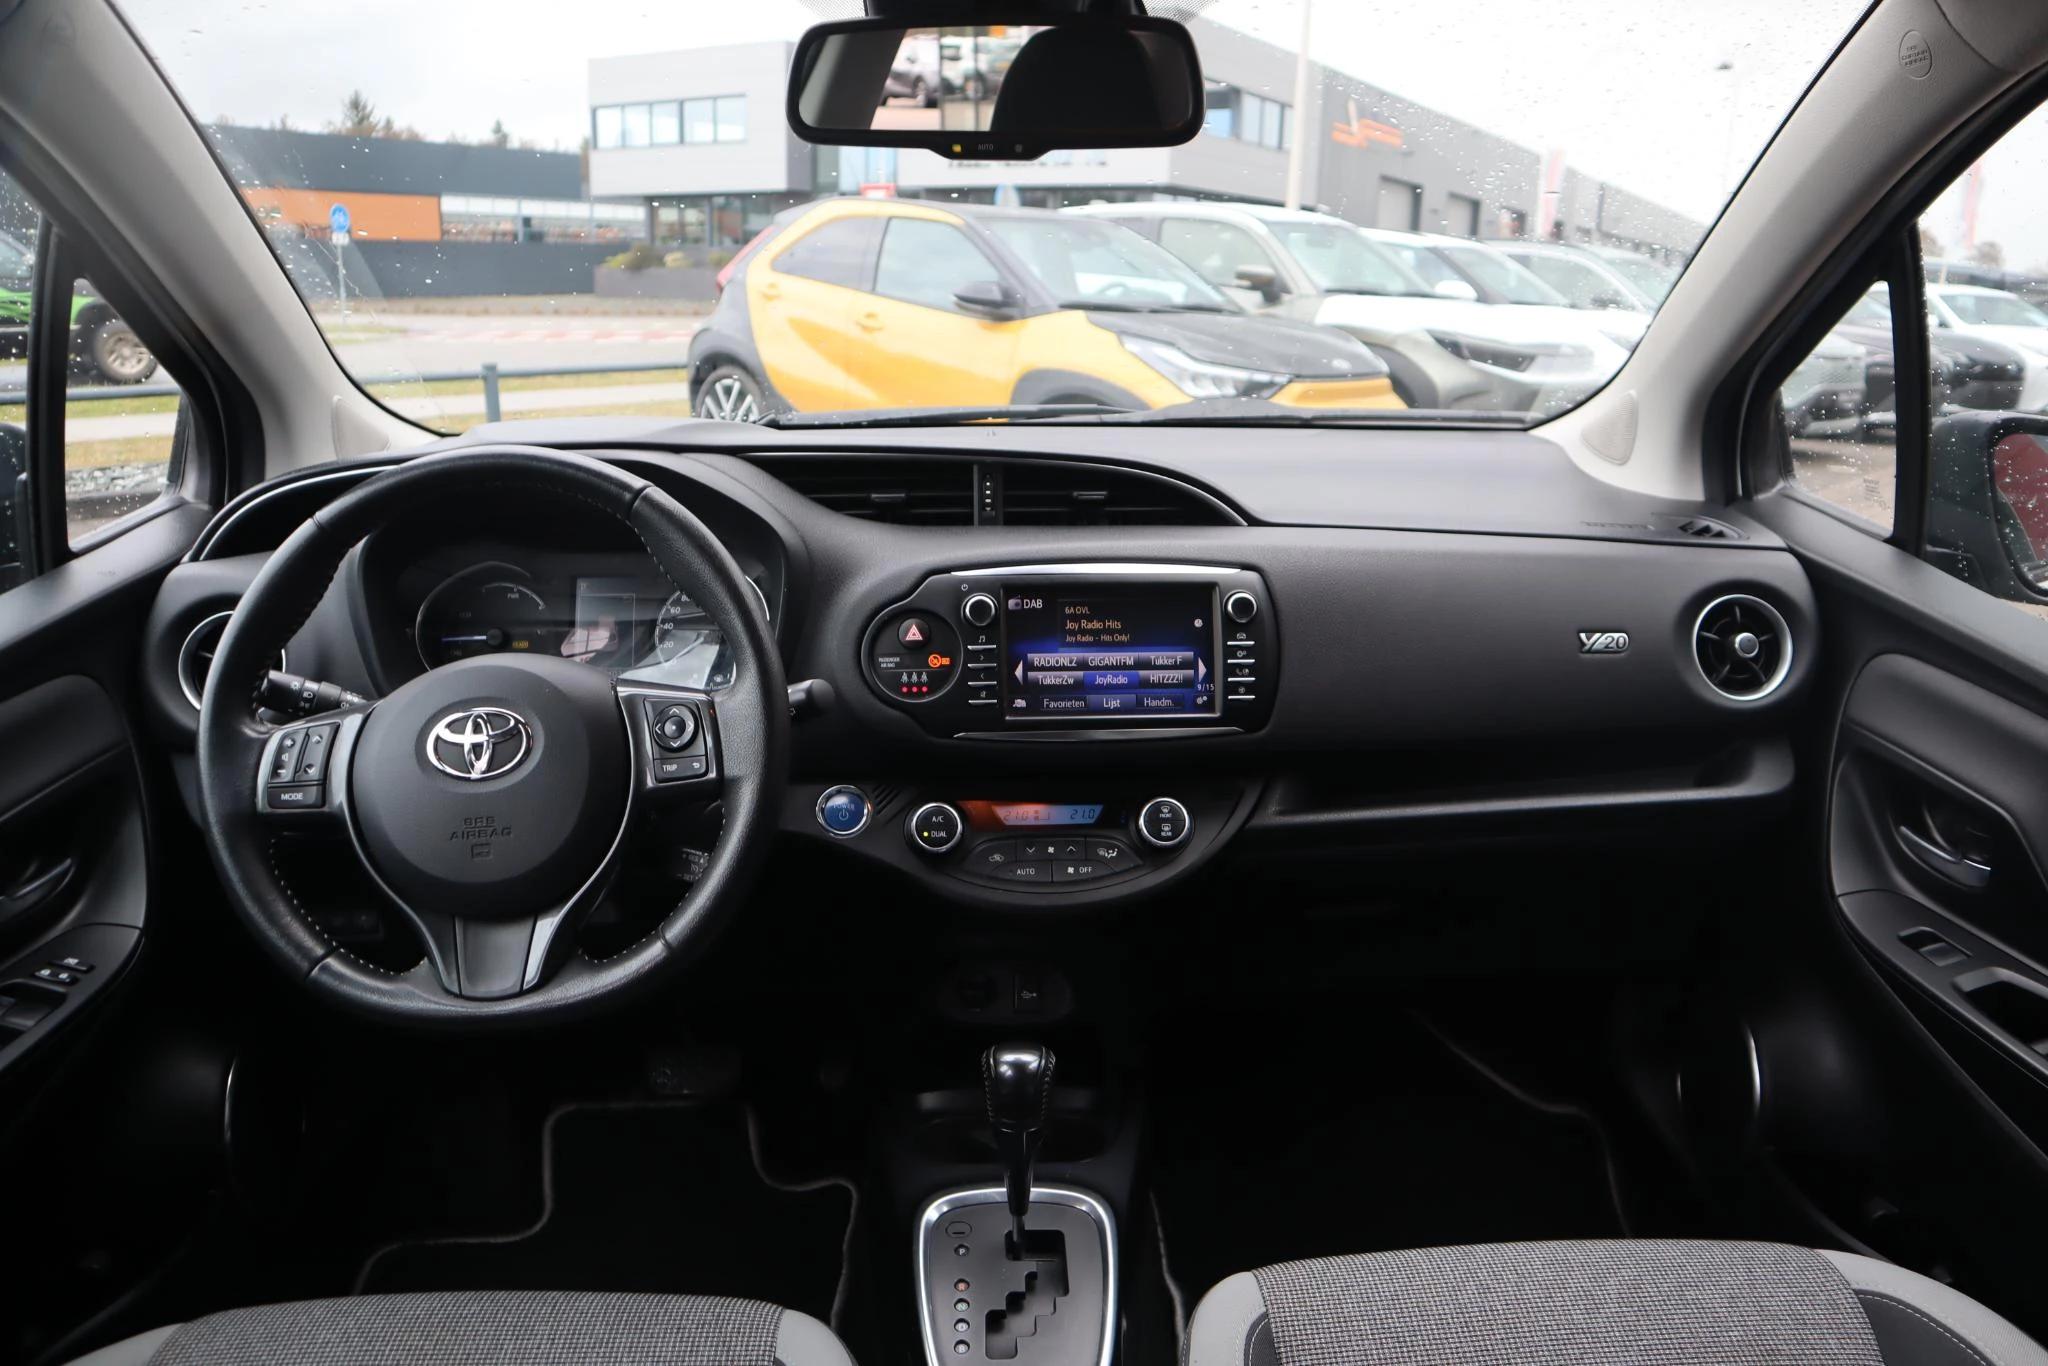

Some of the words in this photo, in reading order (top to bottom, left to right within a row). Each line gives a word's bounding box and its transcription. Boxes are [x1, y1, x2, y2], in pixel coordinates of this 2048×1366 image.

[978, 143, 994, 151] AUTO
[1023, 599, 1043, 609] DAB
[670, 606, 681, 614] 60
[1065, 606, 1075, 614] 6A
[1076, 606, 1090, 614] OVL
[662, 623, 674, 631] 40
[1065, 620, 1079, 631] Joy
[1081, 620, 1104, 630] Radio
[1105, 620, 1122, 629] Hits
[1065, 634, 1076, 643] Joy
[1077, 634, 1094, 642] Radio
[1100, 634, 1112, 642] Hits
[1113, 634, 1130, 643] Only!
[662, 641, 674, 649] 20
[1088, 656, 1134, 666] GIGANTFM
[1150, 655, 1175, 666] Tukker
[1176, 655, 1183, 665] F
[1038, 675, 1074, 685] TukkerZw
[1094, 674, 1129, 686] JoyRadio
[1150, 673, 1183, 684] HITZZZ!!
[1197, 683, 1215, 692] 9/15
[1043, 698, 1085, 708] Favorieten
[1103, 697, 1121, 709] Lijst
[1143, 697, 1174, 708] Handm.
[662, 763, 678, 772] TRIP
[280, 792, 304, 801] MODE
[1070, 808, 1096, 820] 21.0
[450, 828, 512, 840] AIRBAG
[1016, 867, 1036, 876] AUTO
[1079, 866, 1093, 874] OFF
